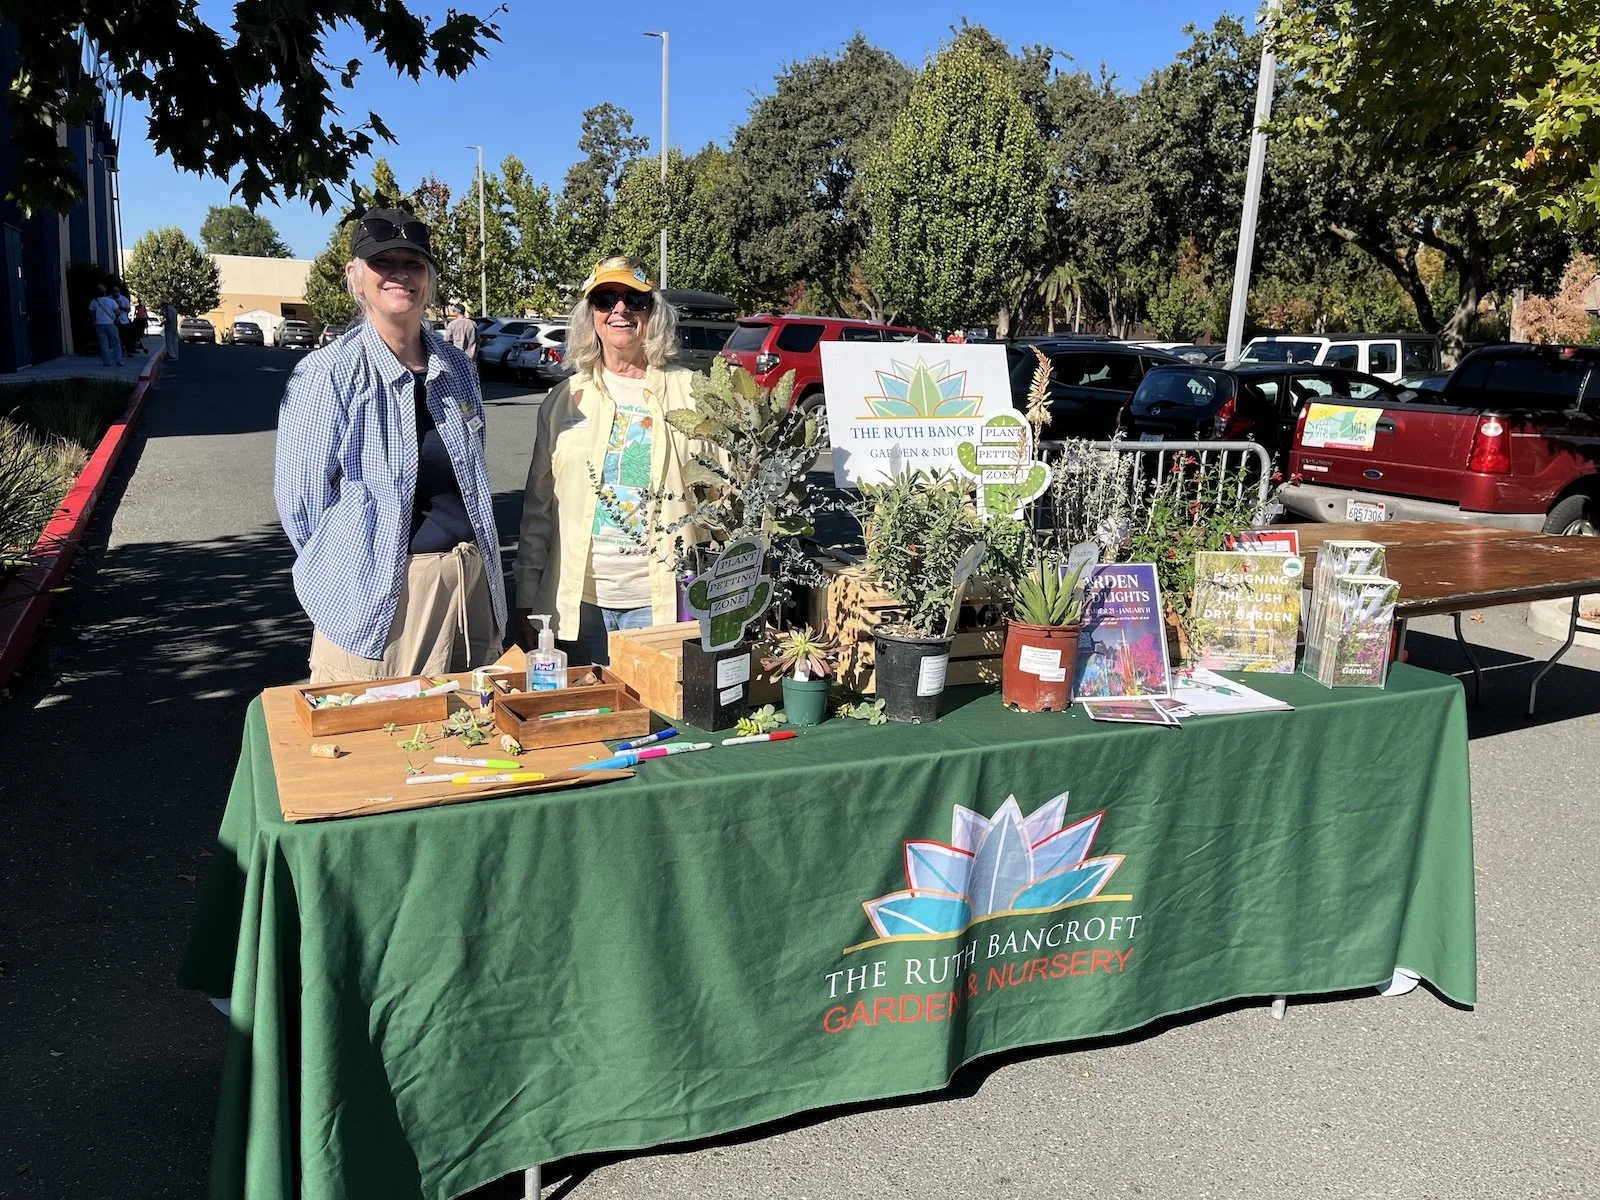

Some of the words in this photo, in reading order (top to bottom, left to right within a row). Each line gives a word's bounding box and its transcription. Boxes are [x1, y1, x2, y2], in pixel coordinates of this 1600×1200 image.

[850, 427, 880, 439] THE
[884, 426, 924, 439] RUTH
[928, 425, 975, 438] BANCR
[921, 448, 930, 457] &
[721, 552, 757, 570] PLANT
[709, 571, 757, 593] PETTING
[1083, 574, 1138, 589] ARDEN
[1213, 572, 1290, 585] DESIGNING
[714, 594, 746, 612] ZONE
[1217, 591, 1243, 603] THE
[1247, 591, 1282, 603] LUSH
[1119, 607, 1145, 615] JANUARY
[1203, 608, 1231, 619] DRY
[1236, 610, 1292, 622] GARDEN
[1342, 667, 1373, 675] Garden
[824, 960, 887, 998] THE
[904, 939, 978, 985] RUTH
[987, 914, 1142, 959] BANCROFT
[823, 987, 962, 1034] GARDEN
[966, 973, 979, 999] &
[986, 946, 1134, 992] NURSERY
